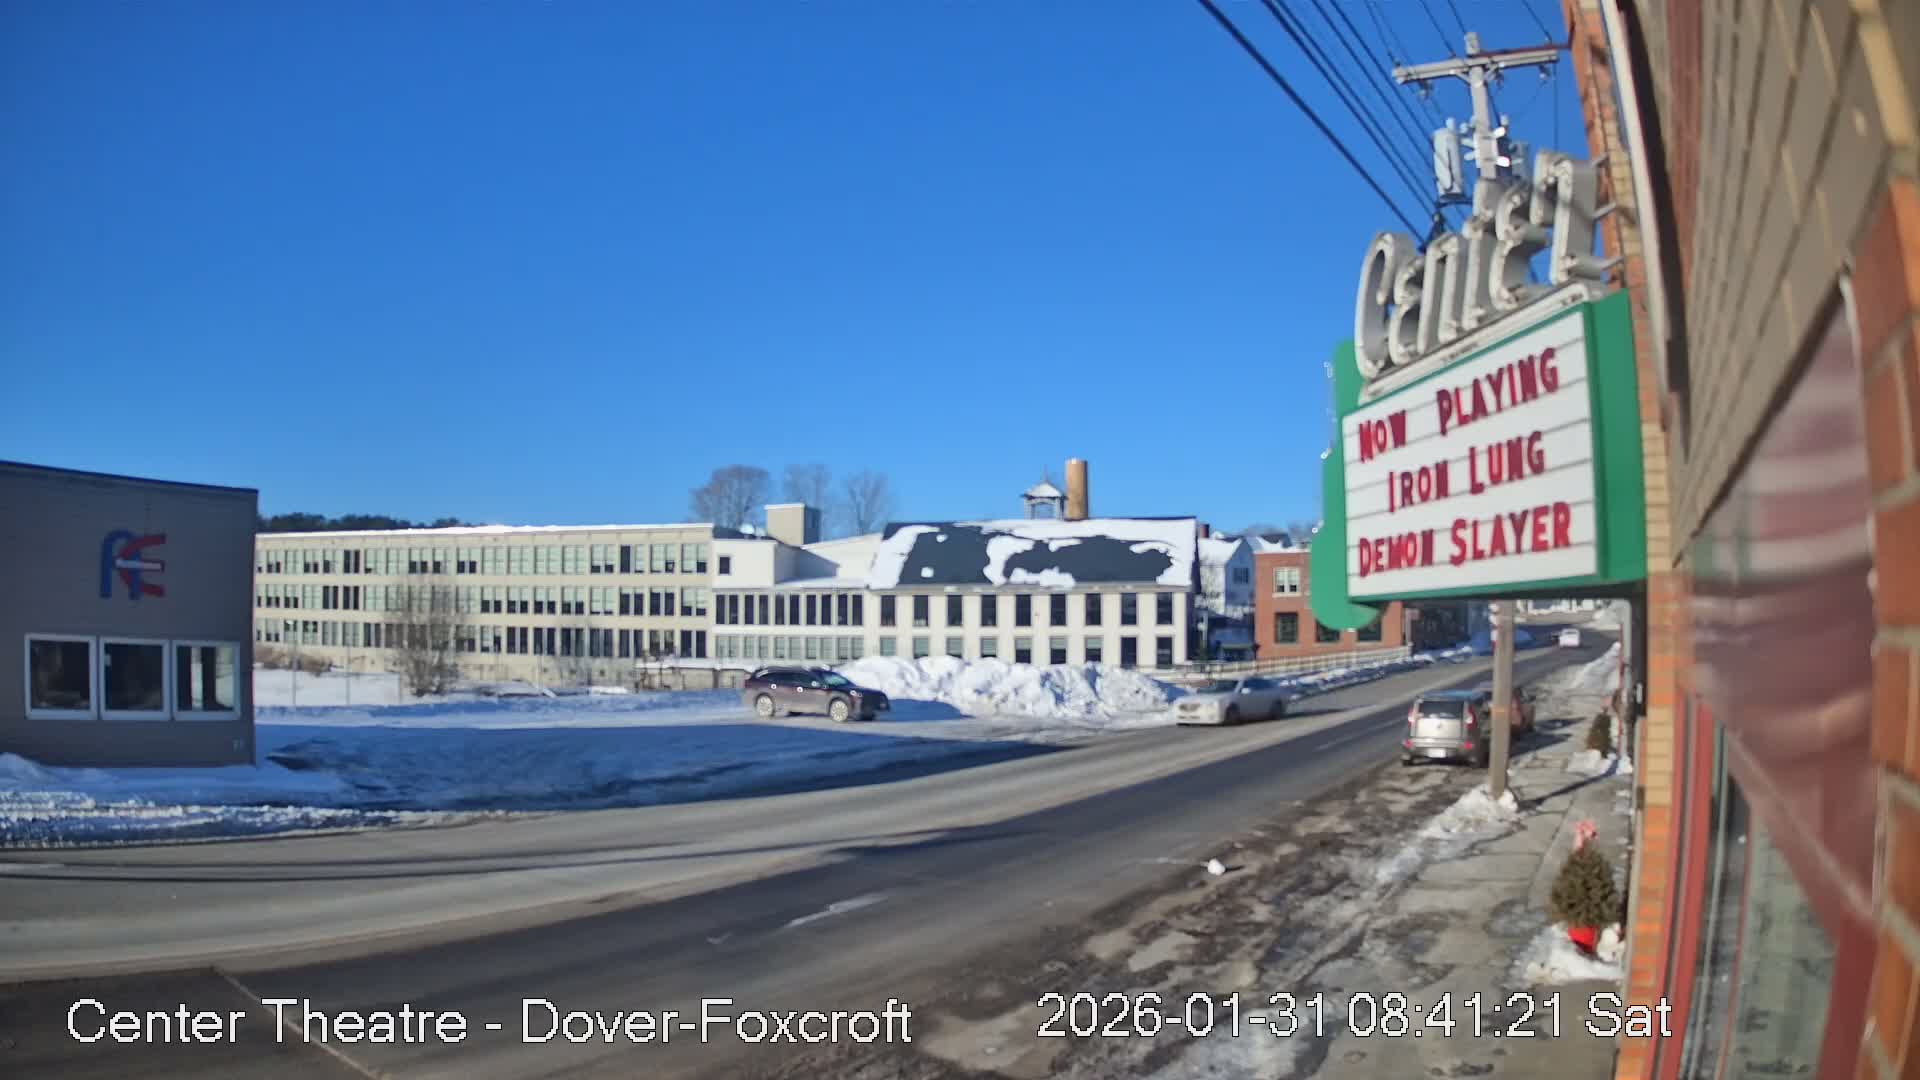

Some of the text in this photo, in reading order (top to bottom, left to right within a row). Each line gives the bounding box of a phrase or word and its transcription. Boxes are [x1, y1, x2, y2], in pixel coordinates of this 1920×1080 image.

[1358, 347, 1559, 463] NOW PLAYING
[1388, 430, 1545, 514] IRON LUNG
[1359, 501, 1571, 578] DEMON SLAYER
